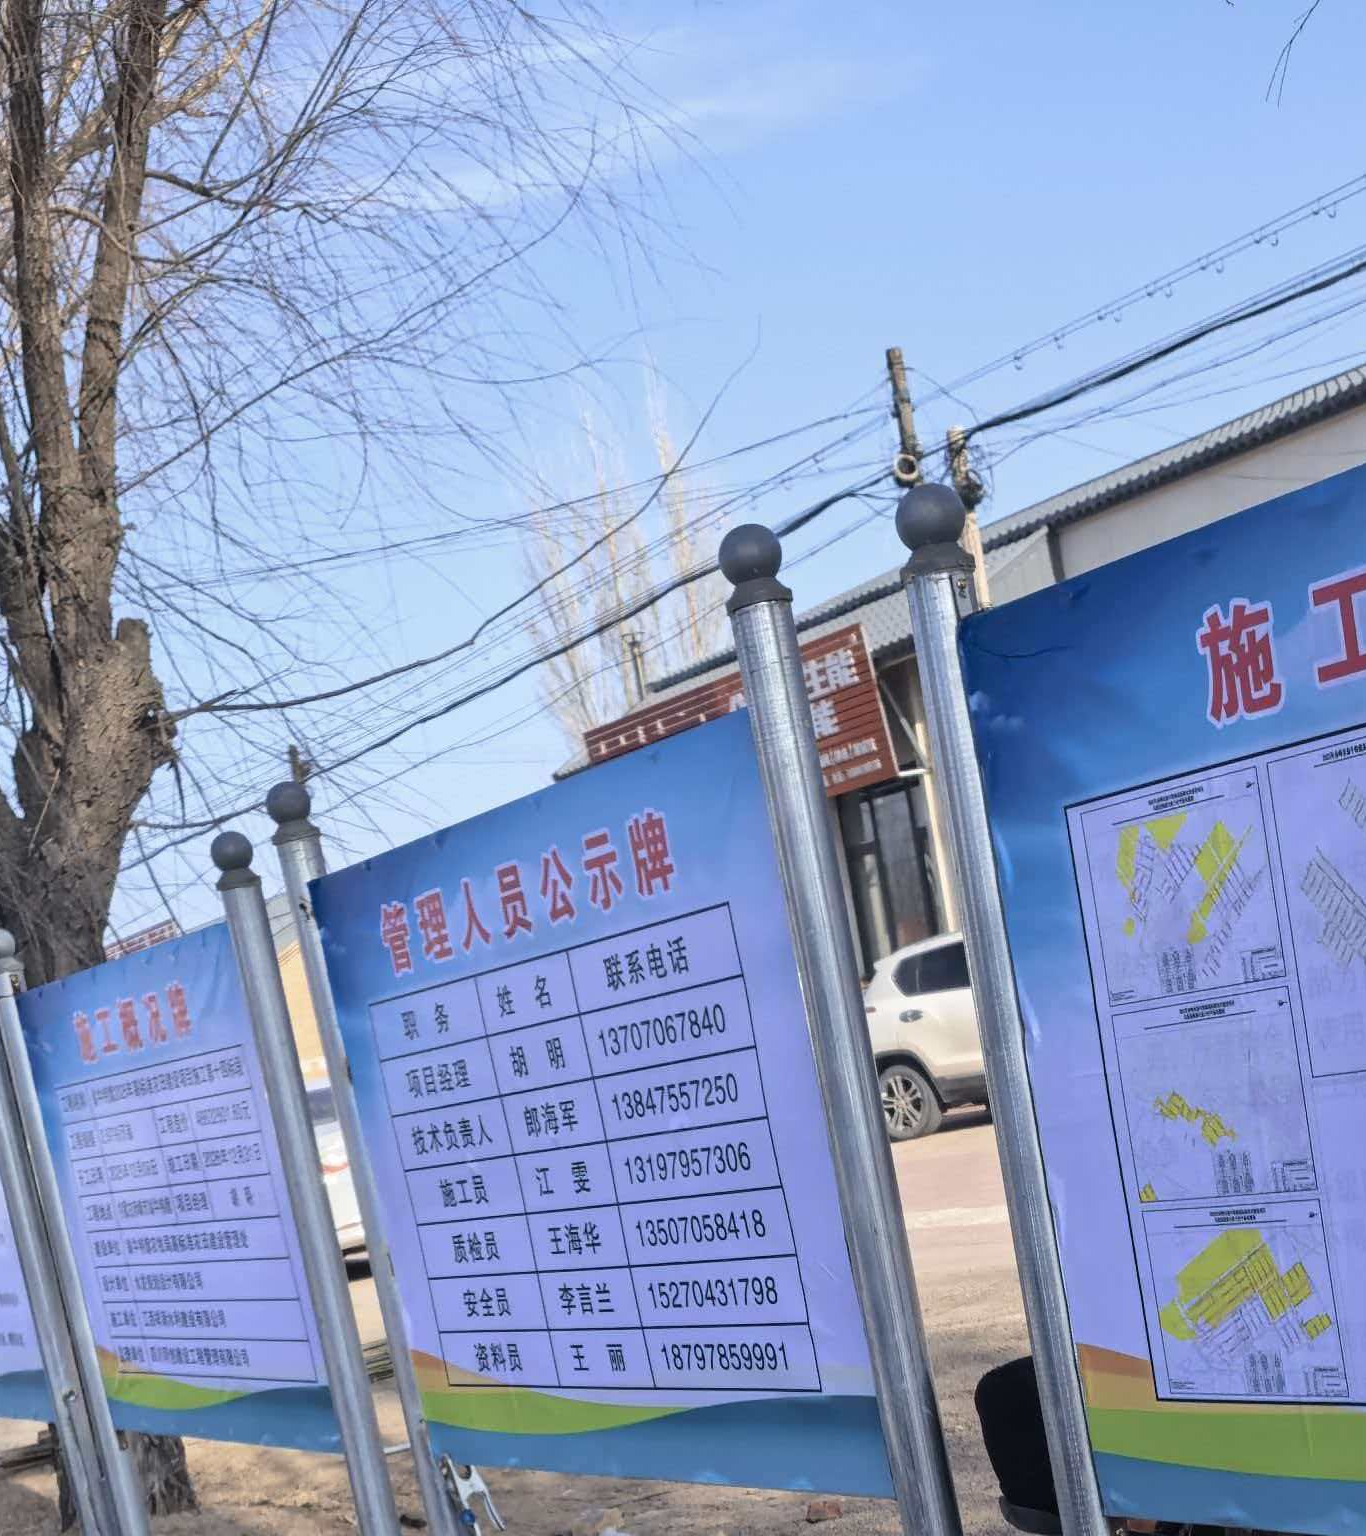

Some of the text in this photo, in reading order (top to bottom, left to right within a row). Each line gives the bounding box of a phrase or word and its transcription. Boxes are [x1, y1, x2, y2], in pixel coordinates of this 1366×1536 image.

[381, 812, 675, 973] 管理人员公示牌
[603, 936, 689, 991] 联系电话
[497, 975, 552, 1018] 姓名
[401, 1002, 449, 1040] 职务
[599, 1003, 726, 1057] 13707067840
[509, 1037, 566, 1078] 胡明
[405, 1059, 472, 1098] 项目经理
[612, 1073, 739, 1120] 13847557250
[411, 1114, 493, 1155] 技术负责人
[535, 1161, 591, 1196] 江雯
[624, 1142, 751, 1184] 13197957306
[439, 1175, 489, 1208] 施工员
[451, 1231, 500, 1263] 质检员
[547, 1221, 602, 1255] 王海华
[636, 1209, 766, 1247] 13507058418
[463, 1287, 511, 1317] 安全员
[558, 1282, 615, 1315] 李言兰
[647, 1276, 778, 1309] 15270431798
[474, 1343, 523, 1372] 资料员
[570, 1343, 626, 1372] 王丽
[661, 1342, 788, 1371] 18797859991
